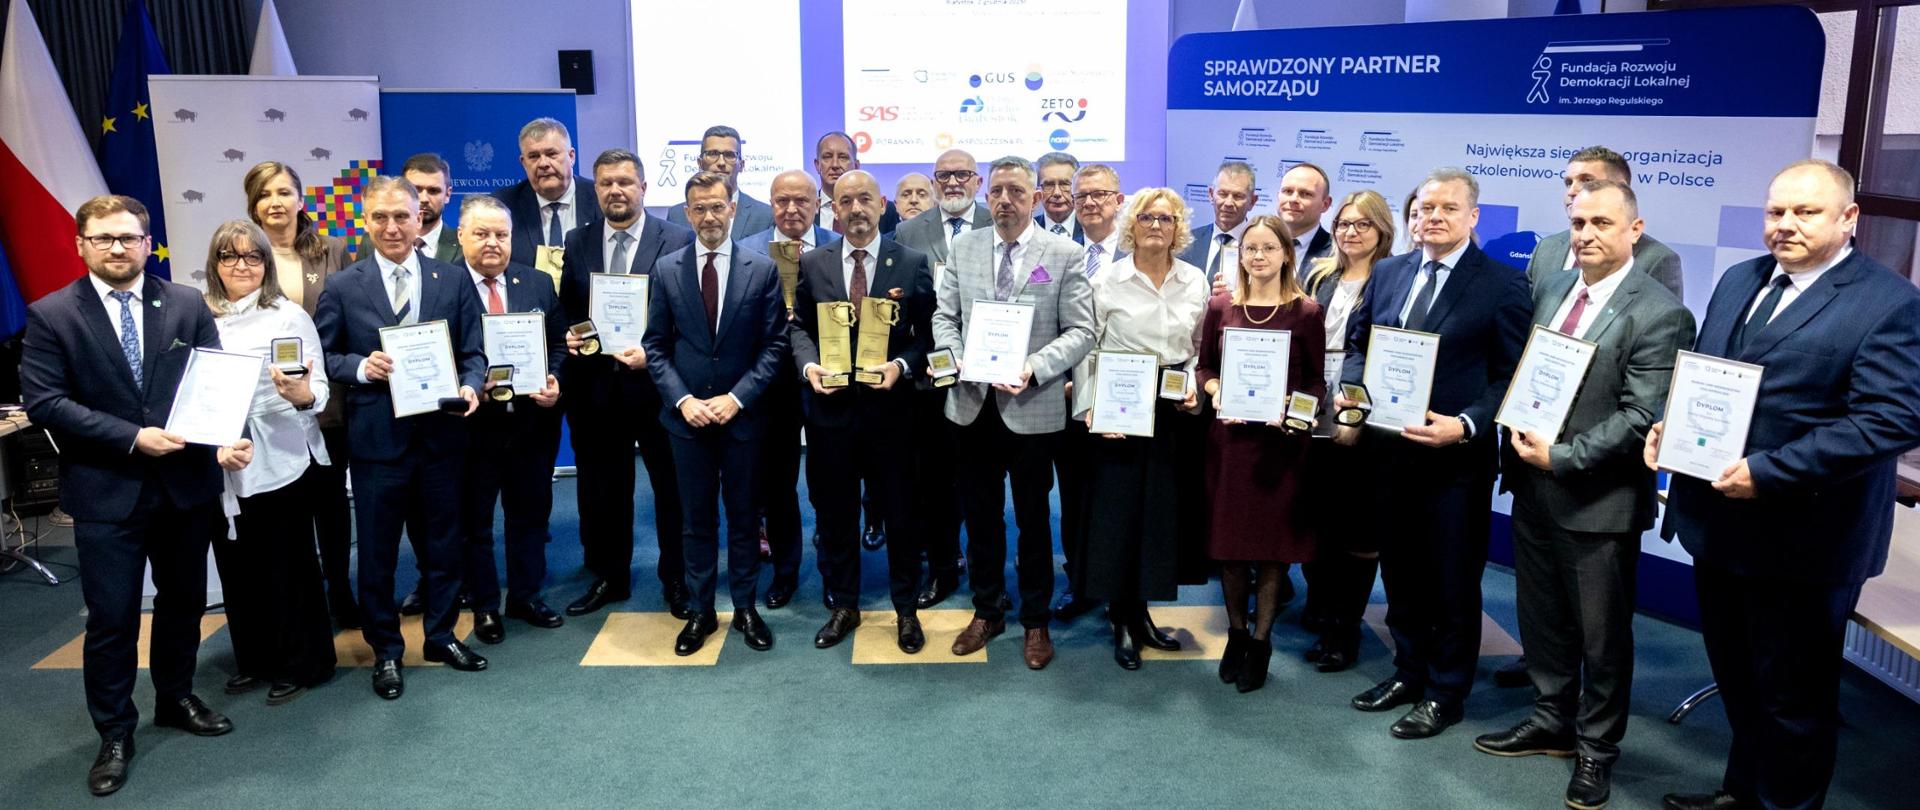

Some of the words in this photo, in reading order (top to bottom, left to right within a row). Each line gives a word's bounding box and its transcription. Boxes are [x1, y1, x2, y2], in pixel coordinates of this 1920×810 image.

[1204, 57, 1336, 76] SPRAWDZONY
[1341, 55, 1440, 75] PARTNER
[1561, 62, 1617, 75] Fundacja
[1621, 60, 1676, 74] Rozwoju
[984, 72, 1016, 84] GUS
[1560, 76, 1630, 89] Demokracji
[1634, 75, 1690, 89] Lokalnej
[1204, 79, 1319, 101] SAMORZĄDU
[1041, 98, 1075, 109] ZETO
[1573, 97, 1607, 106] Jerzego
[1608, 97, 1664, 106] Regulskiego
[859, 105, 900, 122] SAS
[1466, 144, 1546, 161] Największa
[1622, 152, 1723, 169] organizacja
[1637, 173, 1652, 184] w
[1657, 172, 1715, 187] Polsce
[1695, 401, 1724, 413] DYPLOM
